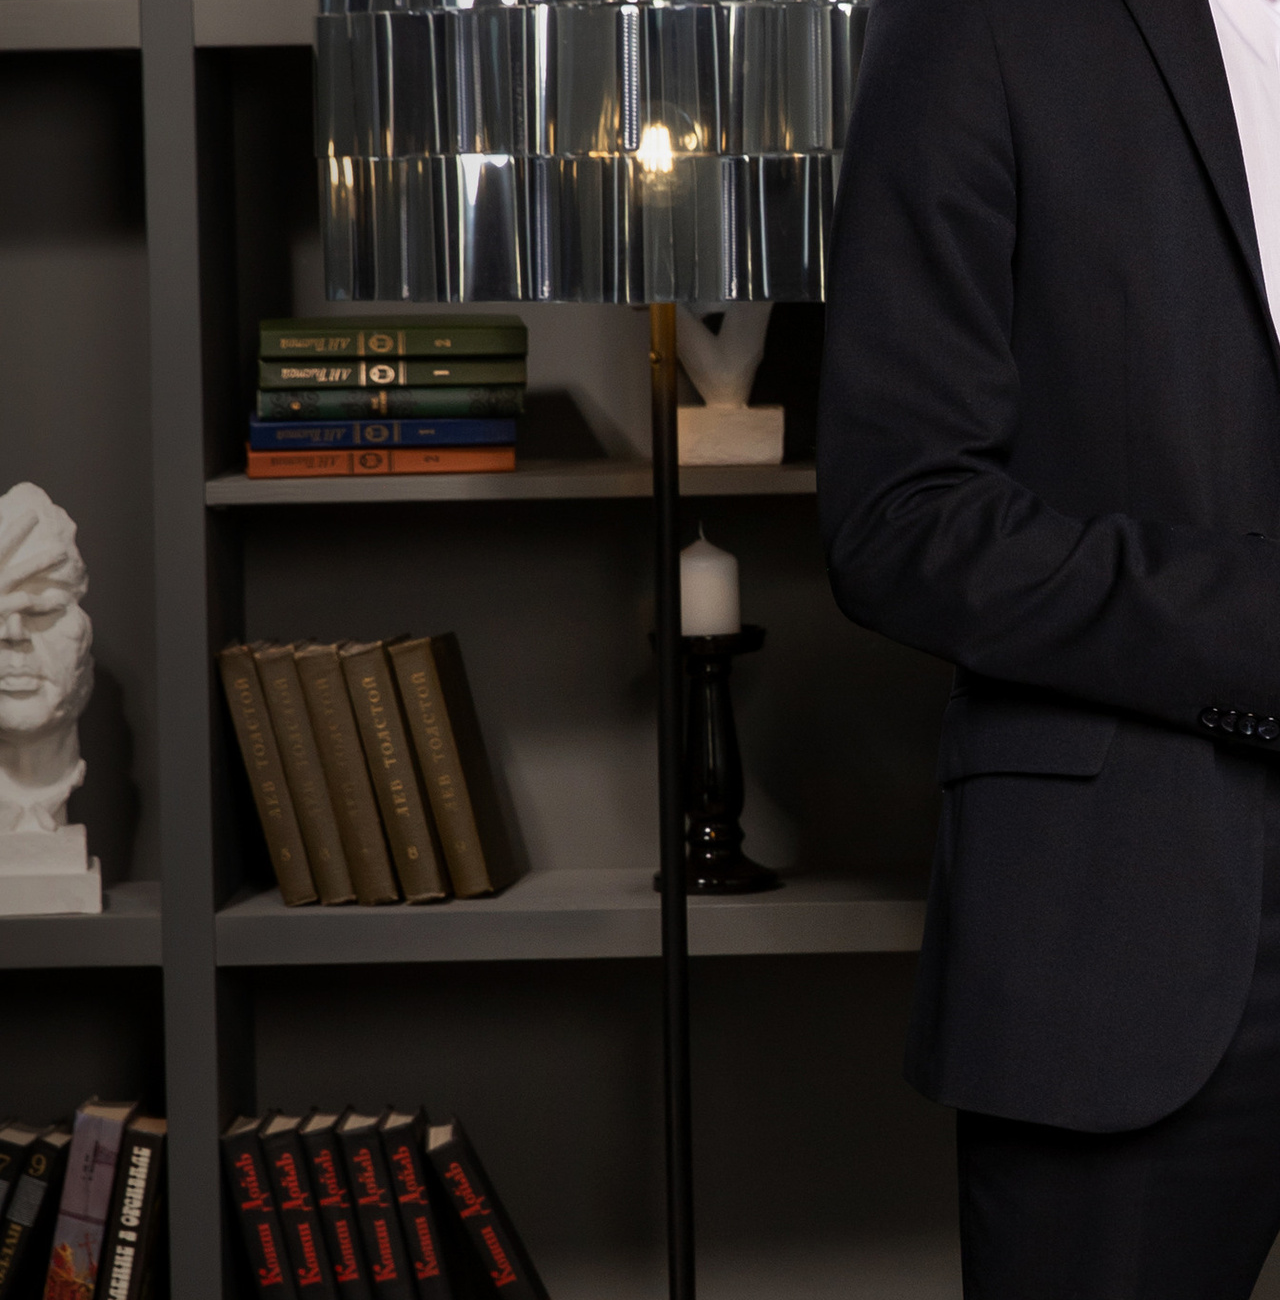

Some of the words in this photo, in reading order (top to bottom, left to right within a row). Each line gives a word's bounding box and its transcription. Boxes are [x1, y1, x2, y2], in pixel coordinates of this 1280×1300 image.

[235, 678, 269, 769] ТОЛСТОЙ
[362, 677, 397, 769] ТОЛСТОЙ
[412, 672, 445, 763] ТОЛСТОЙ
[260, 779, 280, 817] ЛЕВ
[389, 778, 410, 818] ЛЕВ
[28, 1153, 48, 1177] 9
[120, 1146, 152, 1226] ОРСИВАЛЕ
[236, 1154, 269, 1211] Дойль
[276, 1153, 310, 1210] Дойль
[315, 1150, 347, 1207] Дойль
[354, 1149, 386, 1206] Дойль
[393, 1147, 426, 1204] Дойль
[446, 1163, 488, 1217] Дойль
[117, 1229, 137, 1241] В
[259, 1224, 282, 1284] Конан
[298, 1224, 321, 1284] Конан
[336, 1221, 358, 1280] Конан
[374, 1220, 396, 1280] Конан
[416, 1217, 438, 1278] Конан
[482, 1227, 515, 1285] Конан
